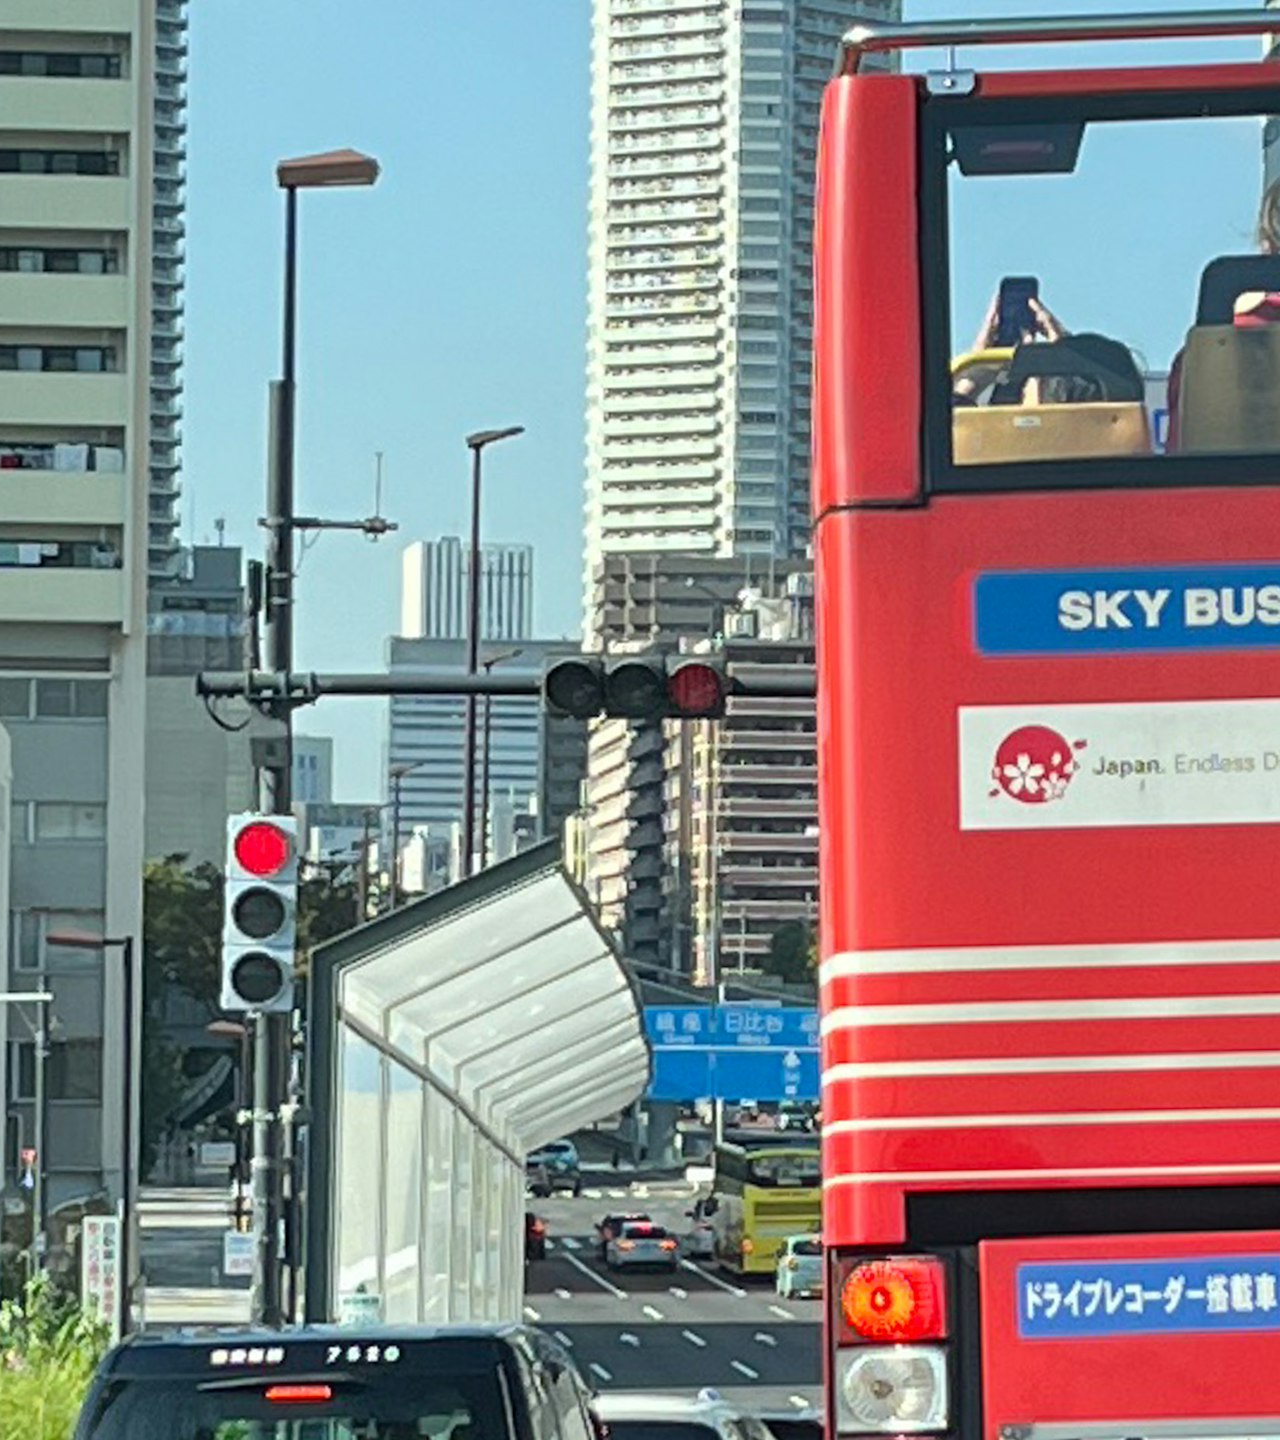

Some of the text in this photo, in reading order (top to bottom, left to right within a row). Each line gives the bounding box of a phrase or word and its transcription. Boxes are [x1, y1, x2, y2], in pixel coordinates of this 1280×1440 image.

[1057, 588, 1173, 631] SKY
[1174, 753, 1256, 774] Endless
[1025, 1272, 1278, 1320] ドライブレコーダー搭載車
